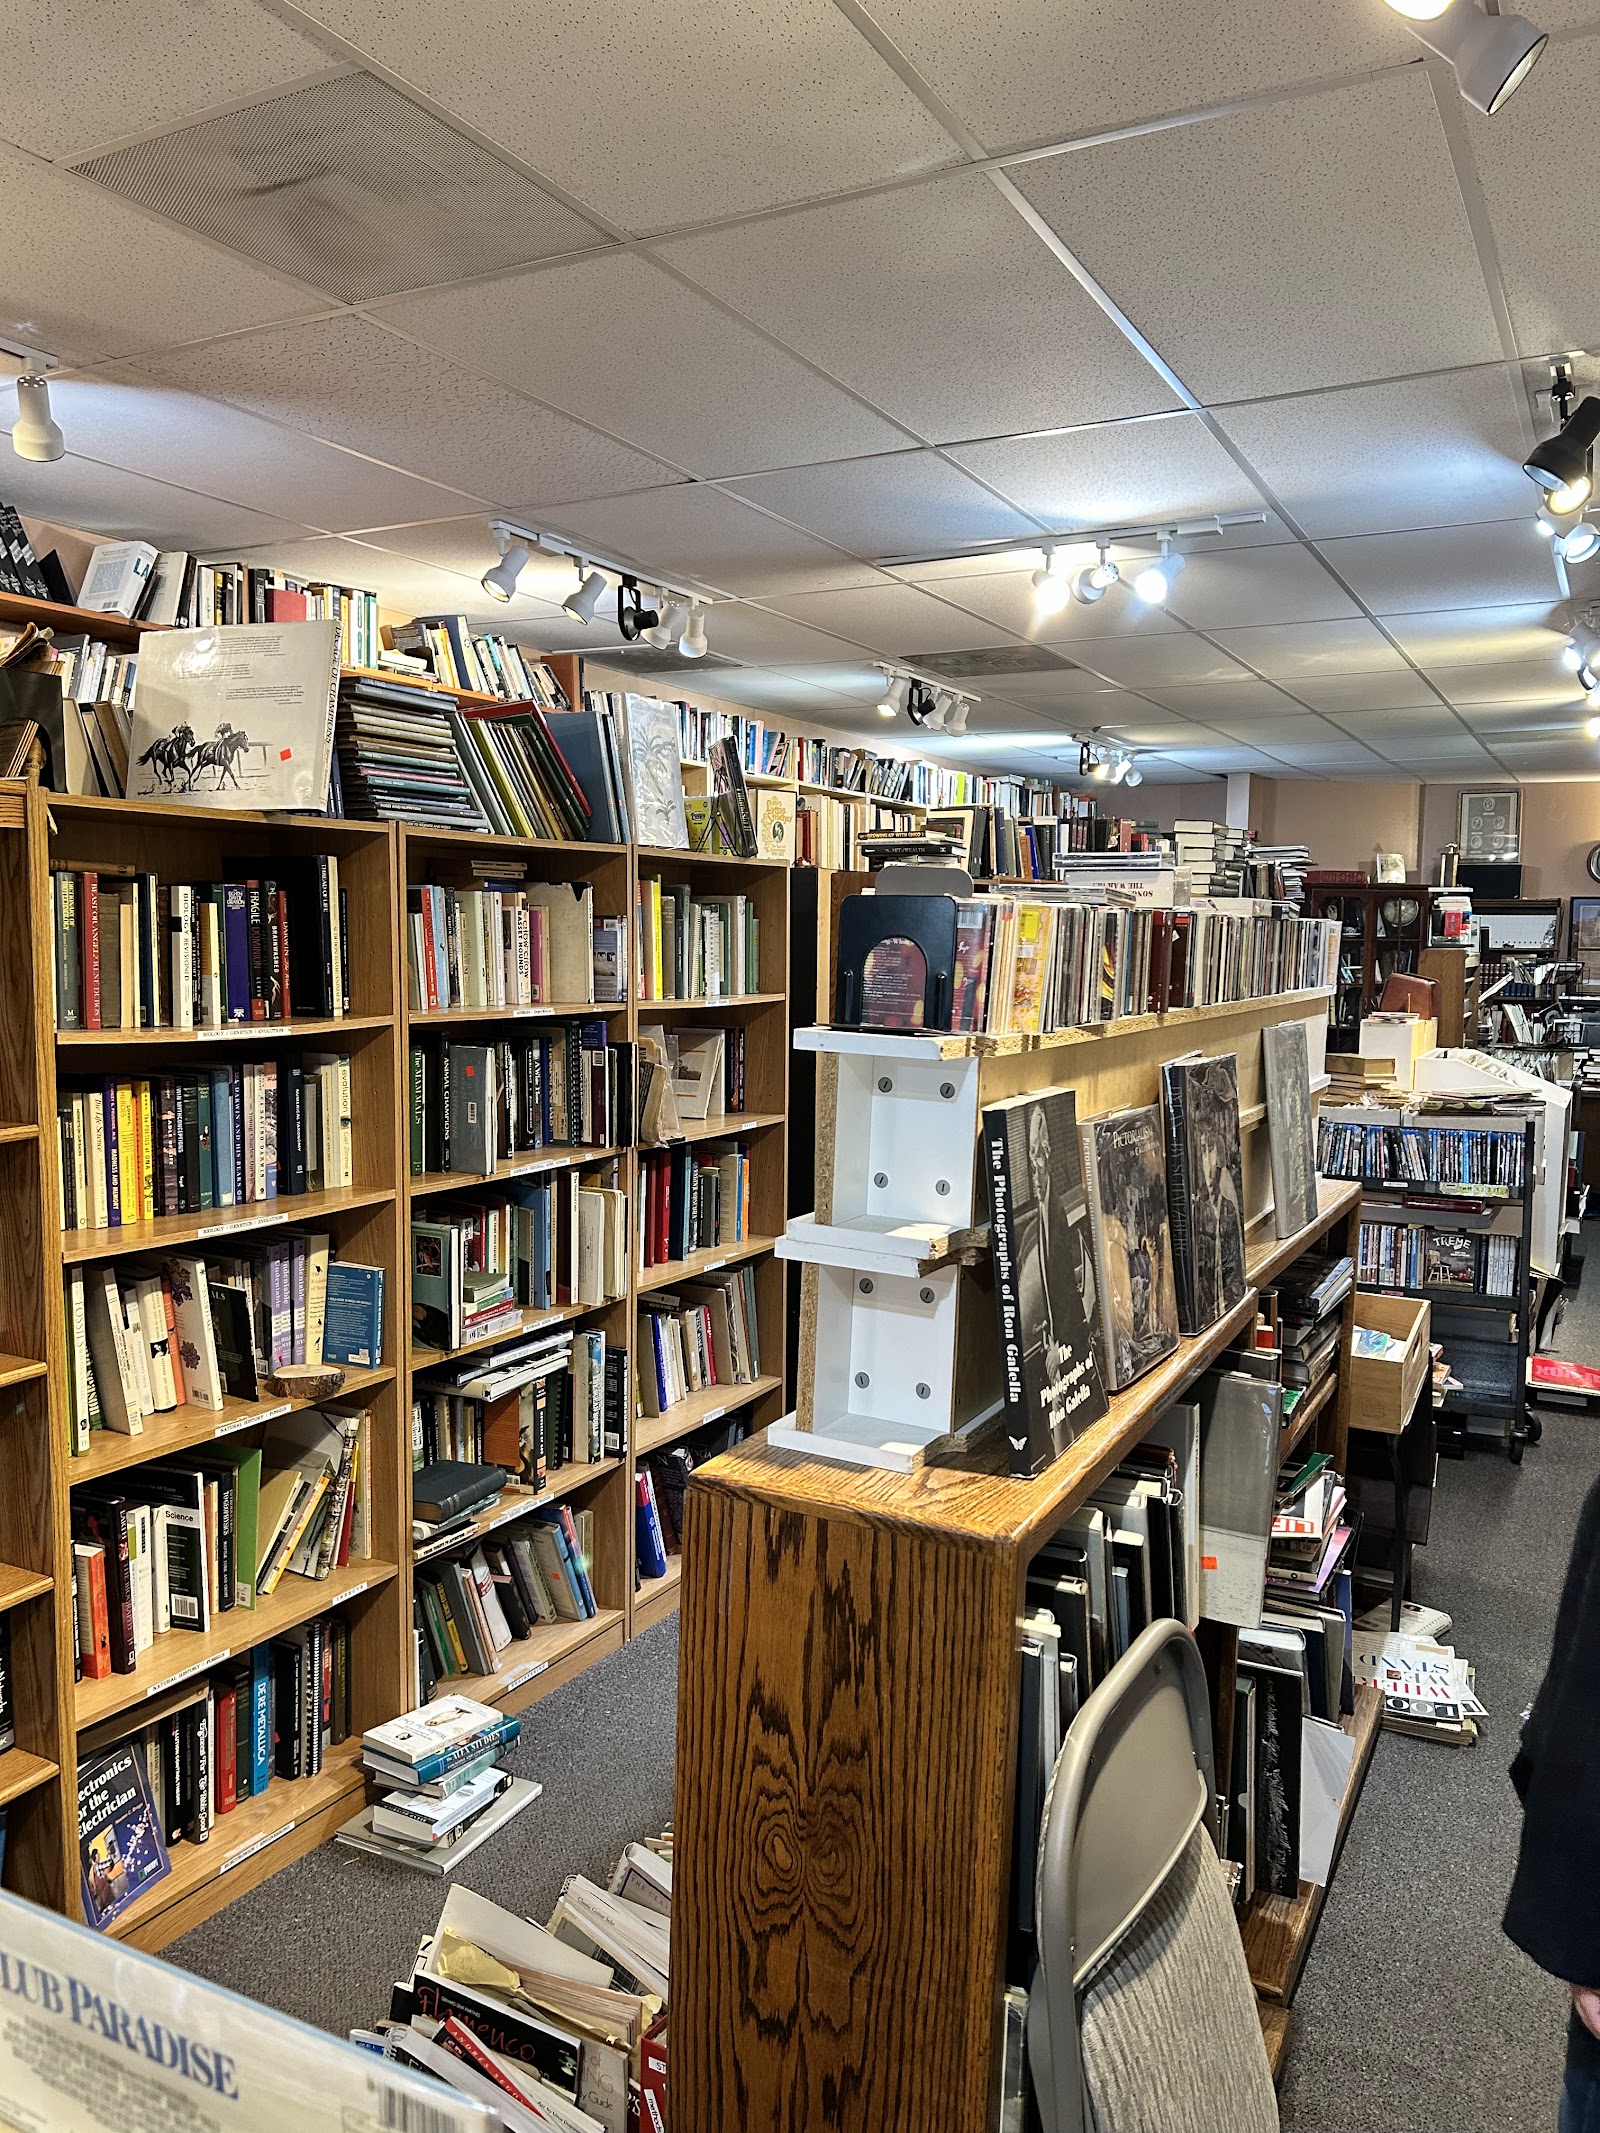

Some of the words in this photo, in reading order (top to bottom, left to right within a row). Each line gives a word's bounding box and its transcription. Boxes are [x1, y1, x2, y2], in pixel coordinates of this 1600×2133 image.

[332, 626, 342, 665] DECADE
[331, 667, 339, 680] OF
[325, 682, 337, 744] CHAMPIONS
[62, 879, 70, 931] BIOTECHNOLOGY
[91, 913, 99, 924] OR
[249, 890, 261, 925] FRAGILE
[69, 917, 75, 928] OF
[91, 926, 99, 960] ANGEL?
[251, 926, 262, 969] DOMINION
[271, 925, 280, 973] BRAINWASHED
[414, 1049, 422, 1068] The
[341, 1069, 349, 1113] evolution
[414, 1068, 423, 1125] MAMMALS
[95, 1111, 103, 1124] Life
[176, 1101, 184, 1153] MYTHCONCEPTIONS
[95, 1126, 104, 1153] Science
[1112, 1125, 1153, 1149] PICTORIALISM
[991, 1137, 1004, 1170] The
[1083, 1137, 1093, 1192] PICTORIALISM
[691, 1168, 699, 1191] VAGINA
[203, 1226, 224, 1234] BIOLOGY
[229, 1222, 253, 1230] GENETICS
[257, 1215, 284, 1225] EVOLUTION
[993, 1175, 1012, 1280] Photographs
[1432, 1236, 1472, 1250] TREME
[274, 1259, 282, 1308] Undeniable
[282, 1257, 290, 1305] Undeniable
[297, 1254, 306, 1302] Undeniable
[1001, 1284, 1015, 1302] of
[74, 1301, 85, 1348] FOSSILS
[1002, 1305, 1016, 1339] Ron
[1058, 1344, 1072, 1364] The
[1006, 1343, 1022, 1403] Galella
[1039, 1361, 1085, 1408] Photographs
[1084, 1351, 1094, 1370] of
[219, 1422, 243, 1433] NATURAL
[243, 1414, 264, 1425] HISTORY
[269, 1407, 287, 1417] FOSSILS
[1048, 1406, 1066, 1430] Ron
[1065, 1383, 1091, 1415] Galella
[119, 1509, 127, 1540] EARTH
[165, 1510, 194, 1522] Science
[1270, 1518, 1311, 1533] LIF
[123, 1562, 131, 1580] THE
[124, 1582, 133, 1631] BIOGRAPHY
[336, 1585, 364, 1602] INSECTS
[152, 1675, 178, 1692] NATURAL
[178, 1663, 201, 1679] HISTORY
[205, 1652, 226, 1665] FOSSILS
[511, 1664, 546, 1688] ENGINEERING
[1359, 1654, 1449, 1674] STAND
[1403, 1671, 1449, 1686] WE
[257, 1682, 266, 1696] DE
[257, 1696, 266, 1710] RE
[1353, 1677, 1451, 1699] WHER
[1386, 1697, 1454, 1718] LOO
[196, 1718, 208, 1756] Engineers
[257, 1712, 266, 1766] METALLICA
[470, 1731, 501, 1748] STUDIES
[77, 1754, 133, 1805] ectronics
[198, 1775, 208, 1790] The
[77, 1807, 89, 1821] or
[88, 1790, 110, 1813] the
[199, 1790, 208, 1813] Public
[198, 1812, 208, 1831] Good
[223, 1845, 255, 1869] ELECTRONICS
[259, 1824, 291, 1848] ENGINEERING
[0, 1953, 64, 2014] LUB
[66, 1974, 239, 2101] PARADISE
[450, 2030, 490, 2070] ANDRES
